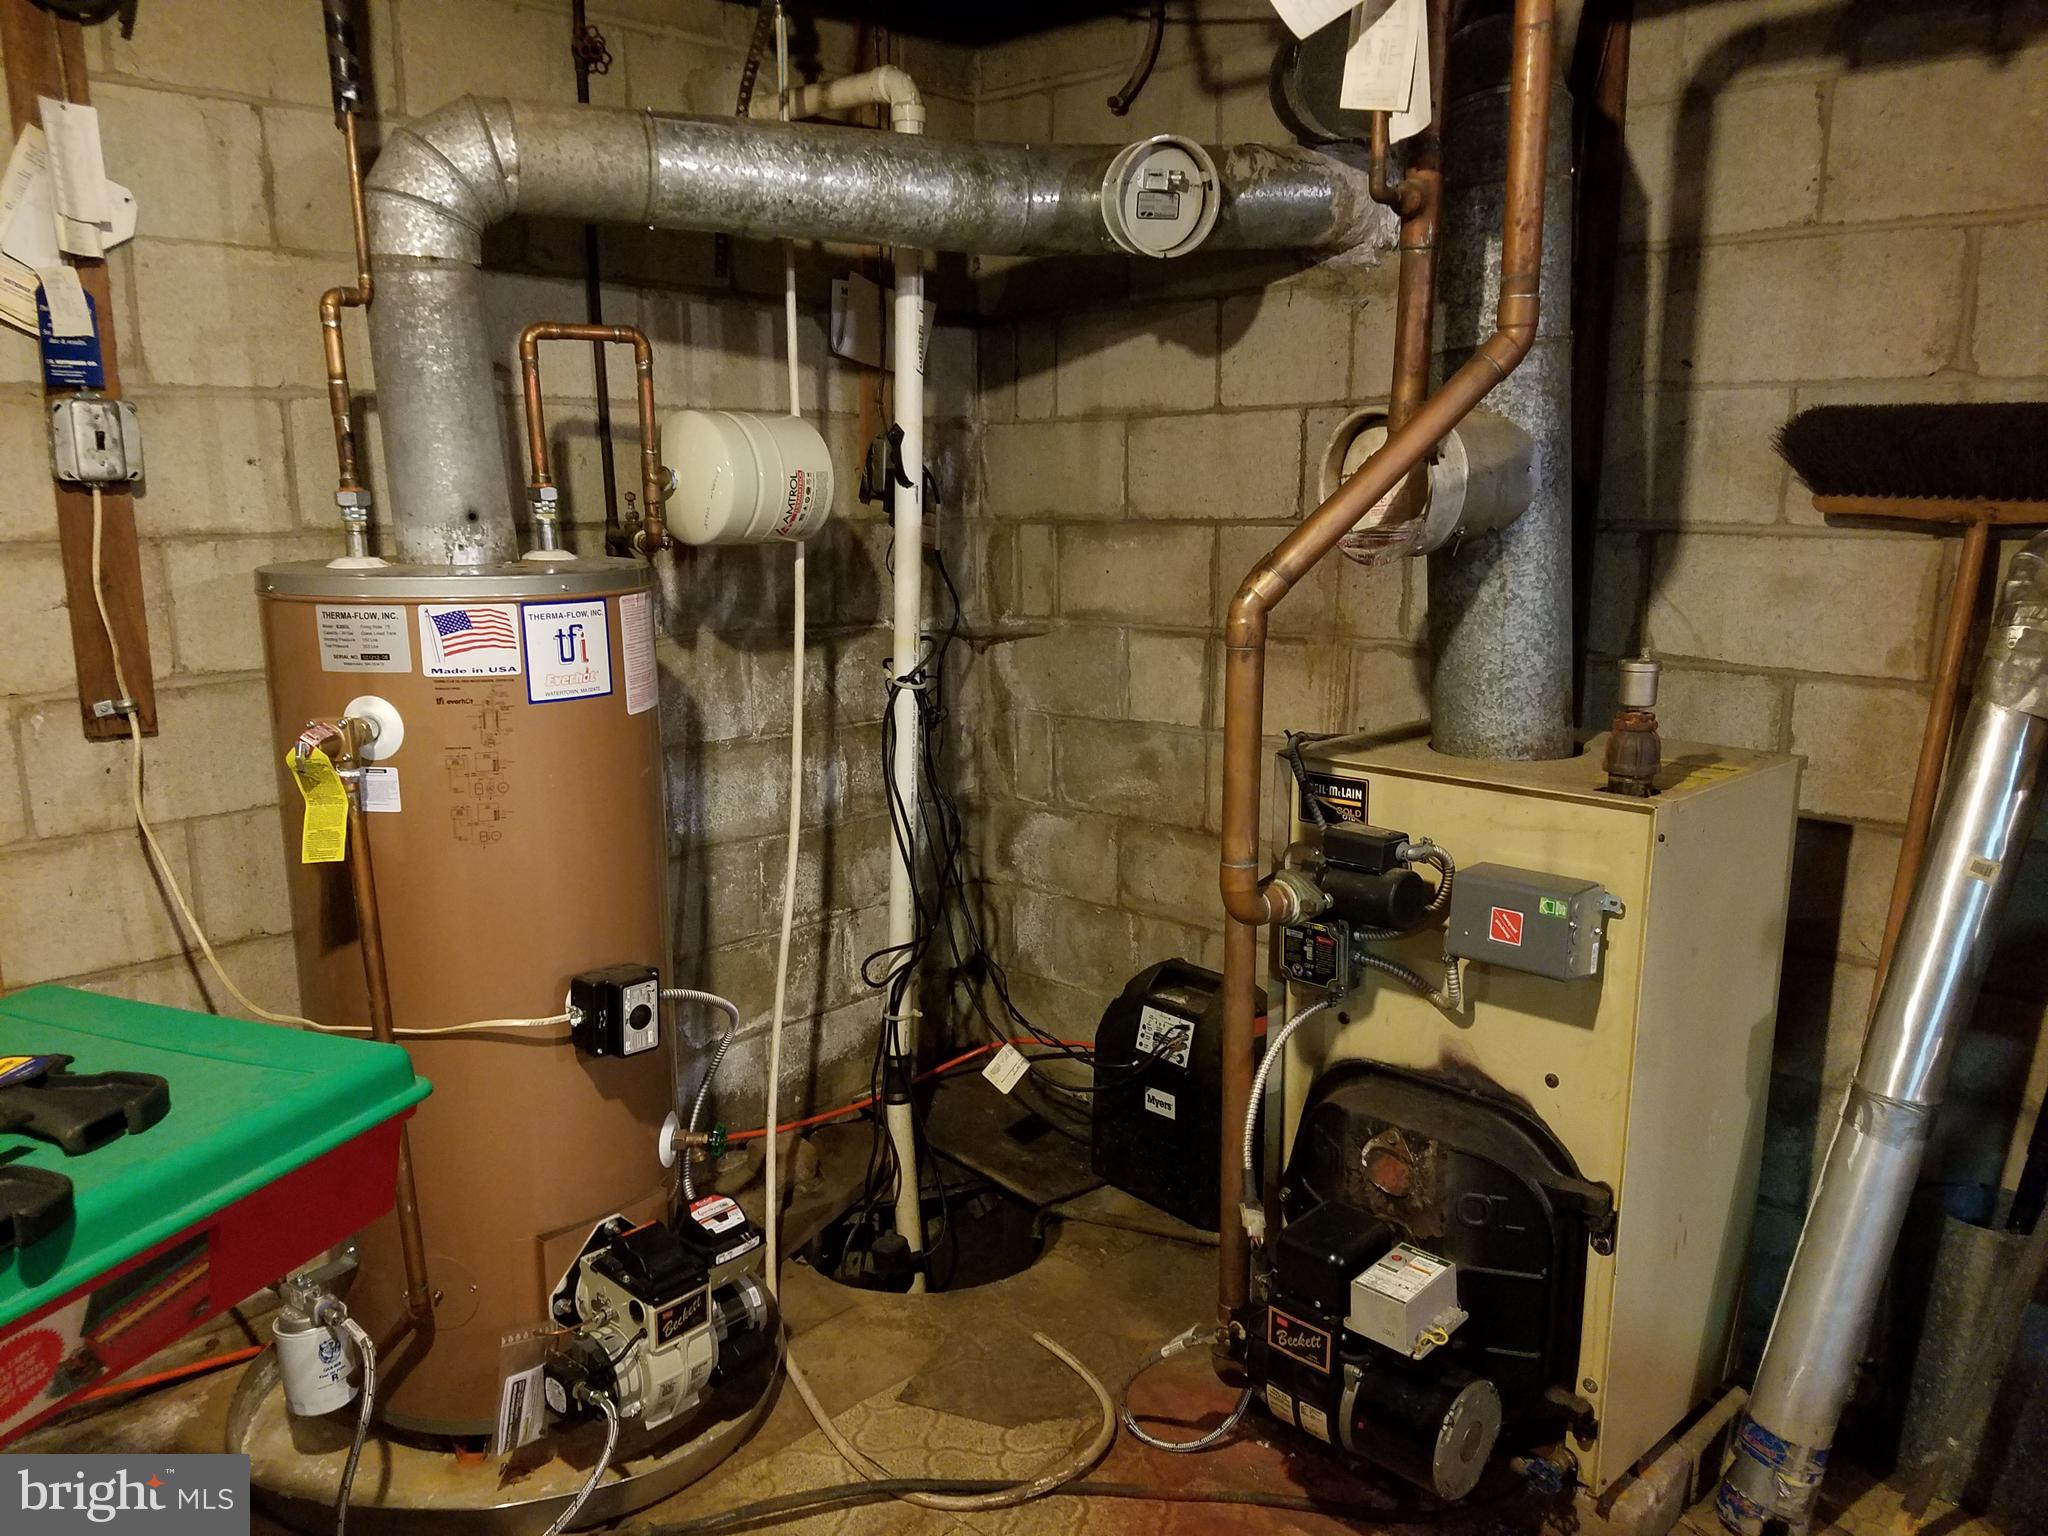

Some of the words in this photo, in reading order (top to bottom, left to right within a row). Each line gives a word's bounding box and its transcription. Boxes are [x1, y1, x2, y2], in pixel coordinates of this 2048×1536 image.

[783, 472, 798, 524] AMTROL
[381, 612, 399, 620] INC.
[590, 609, 604, 617] INC.
[1336, 806, 1361, 817] GOLD
[1147, 1093, 1173, 1111] Myers
[663, 1295, 702, 1338] Beckett
[1276, 1329, 1321, 1349] Beckett
[331, 1373, 338, 1381] R
